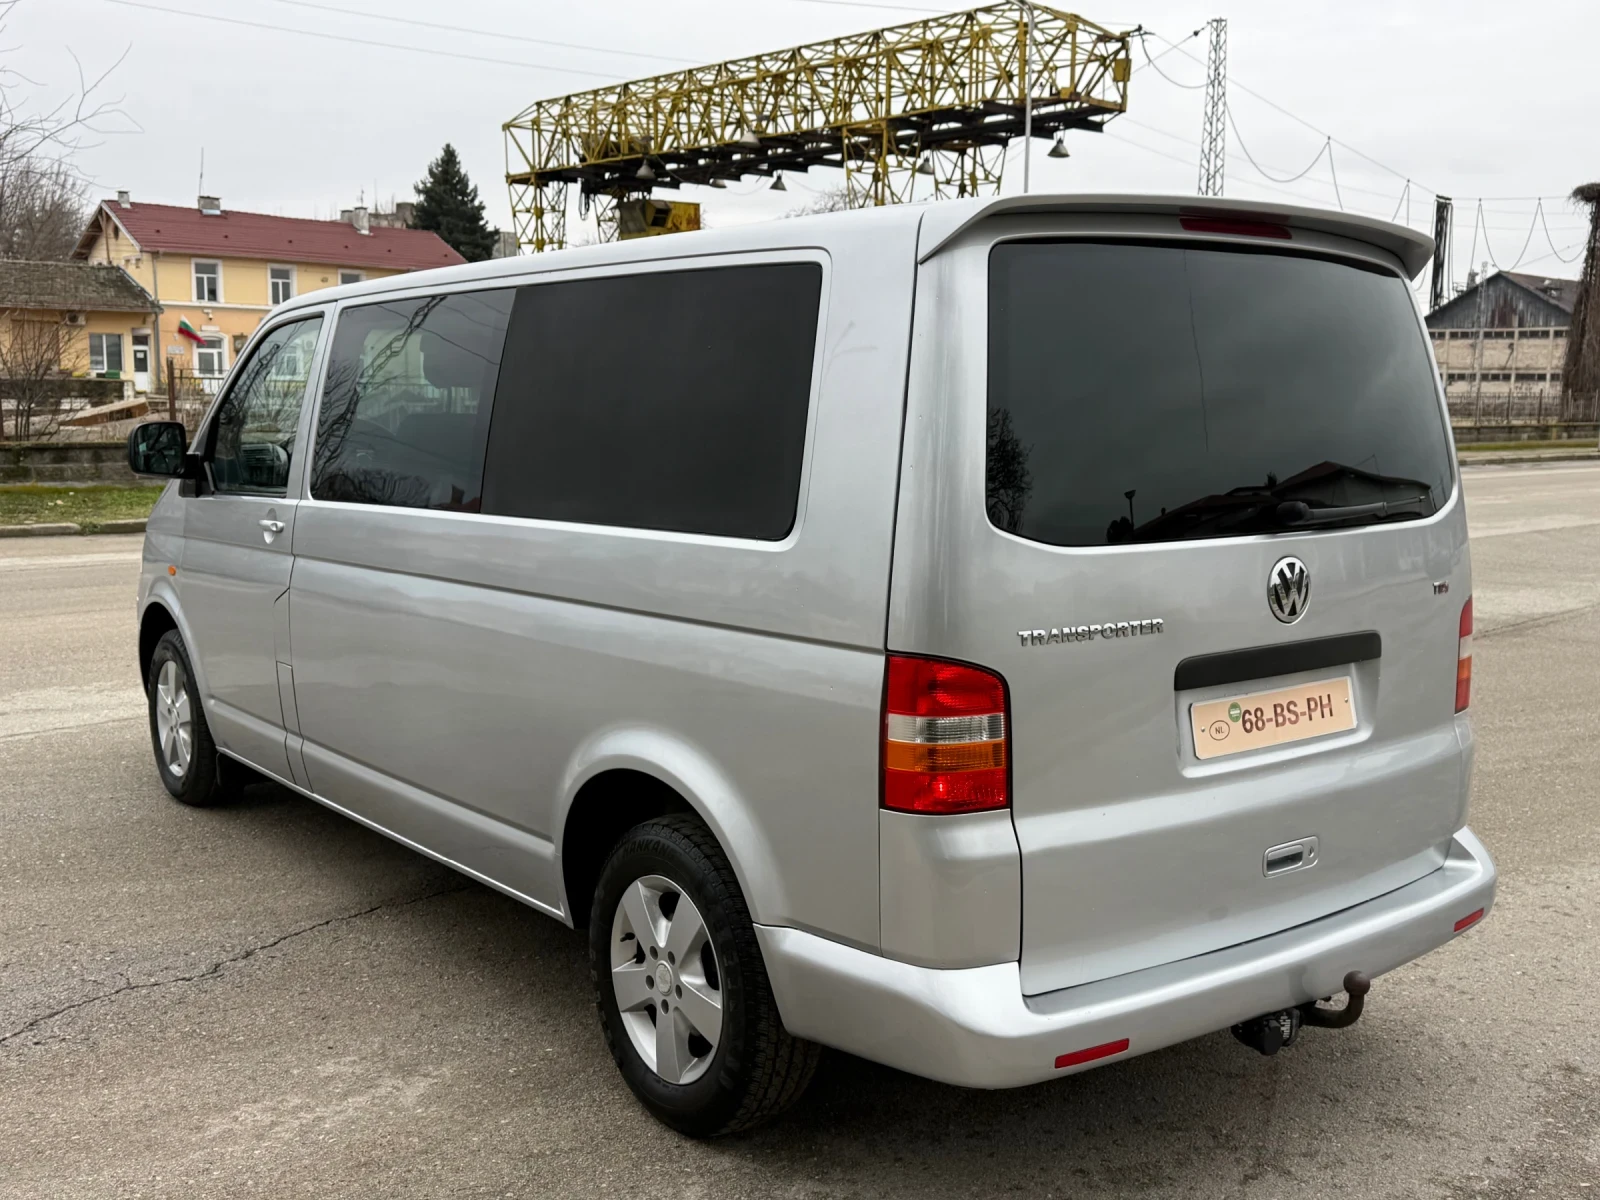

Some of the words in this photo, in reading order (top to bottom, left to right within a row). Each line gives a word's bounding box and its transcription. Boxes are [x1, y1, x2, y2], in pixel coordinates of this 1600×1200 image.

[1270, 558, 1310, 621] VW
[1017, 618, 1164, 647] TRANSPORTER
[1214, 726, 1225, 735] NL
[1241, 693, 1334, 734] 68-BS-PH
